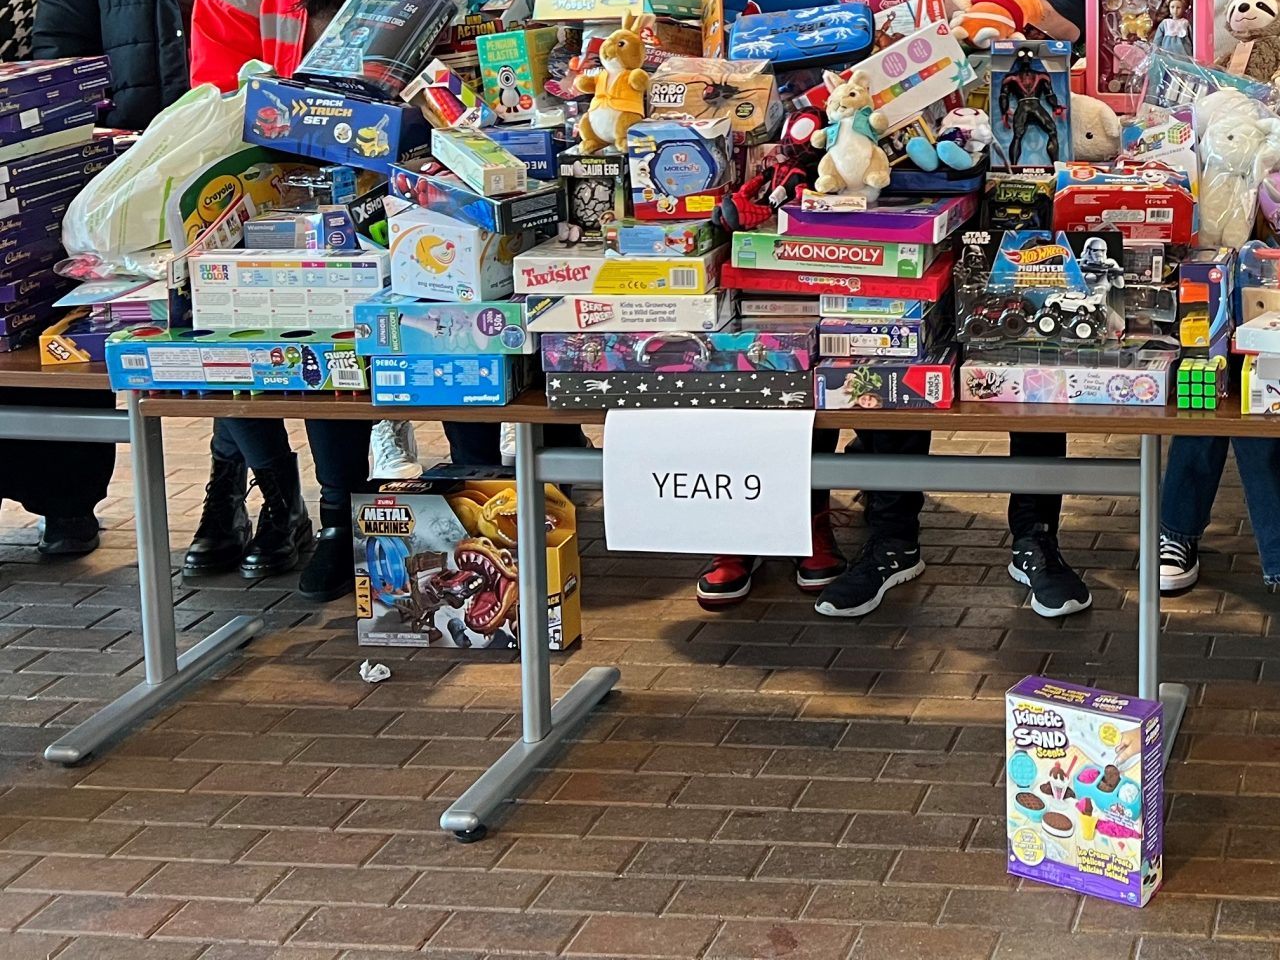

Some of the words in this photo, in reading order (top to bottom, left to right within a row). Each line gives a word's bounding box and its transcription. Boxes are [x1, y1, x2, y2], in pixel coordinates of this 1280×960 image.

[457, 21, 495, 39] ACTION
[651, 83, 685, 95] ROBO
[306, 98, 313, 106] 4
[315, 98, 343, 107] PACK
[651, 93, 684, 104] ALIVE
[303, 116, 330, 126] SET
[604, 163, 619, 176] EGG
[663, 163, 700, 173] Matchify
[204, 182, 236, 207] Crayola
[962, 237, 991, 245] WARS
[963, 231, 990, 239] STAR
[783, 243, 881, 263] MONOPOLY
[199, 264, 229, 273] SUPER
[1018, 264, 1064, 272] MONSTER
[201, 272, 229, 281] COLOR
[522, 263, 592, 288] Twister
[581, 301, 602, 312] BEAT
[495, 313, 503, 331] 450x
[393, 310, 401, 351] MICROSCOPE
[47, 339, 72, 361] 254
[375, 359, 398, 367] 70836
[263, 377, 289, 385] Sand
[933, 373, 941, 401] Science
[464, 394, 500, 403] playmobil
[652, 472, 733, 500] YEAR
[744, 474, 761, 500] 9
[364, 507, 409, 522] METAL
[364, 521, 410, 534] MACHINES
[507, 641, 517, 649] 4+
[1014, 709, 1064, 730] Kinetic
[1014, 728, 1068, 749] SAND
[1035, 747, 1067, 759] Scents
[1078, 846, 1087, 857] Ice
[1088, 848, 1110, 862] Cream
[1111, 854, 1133, 870] Treats
